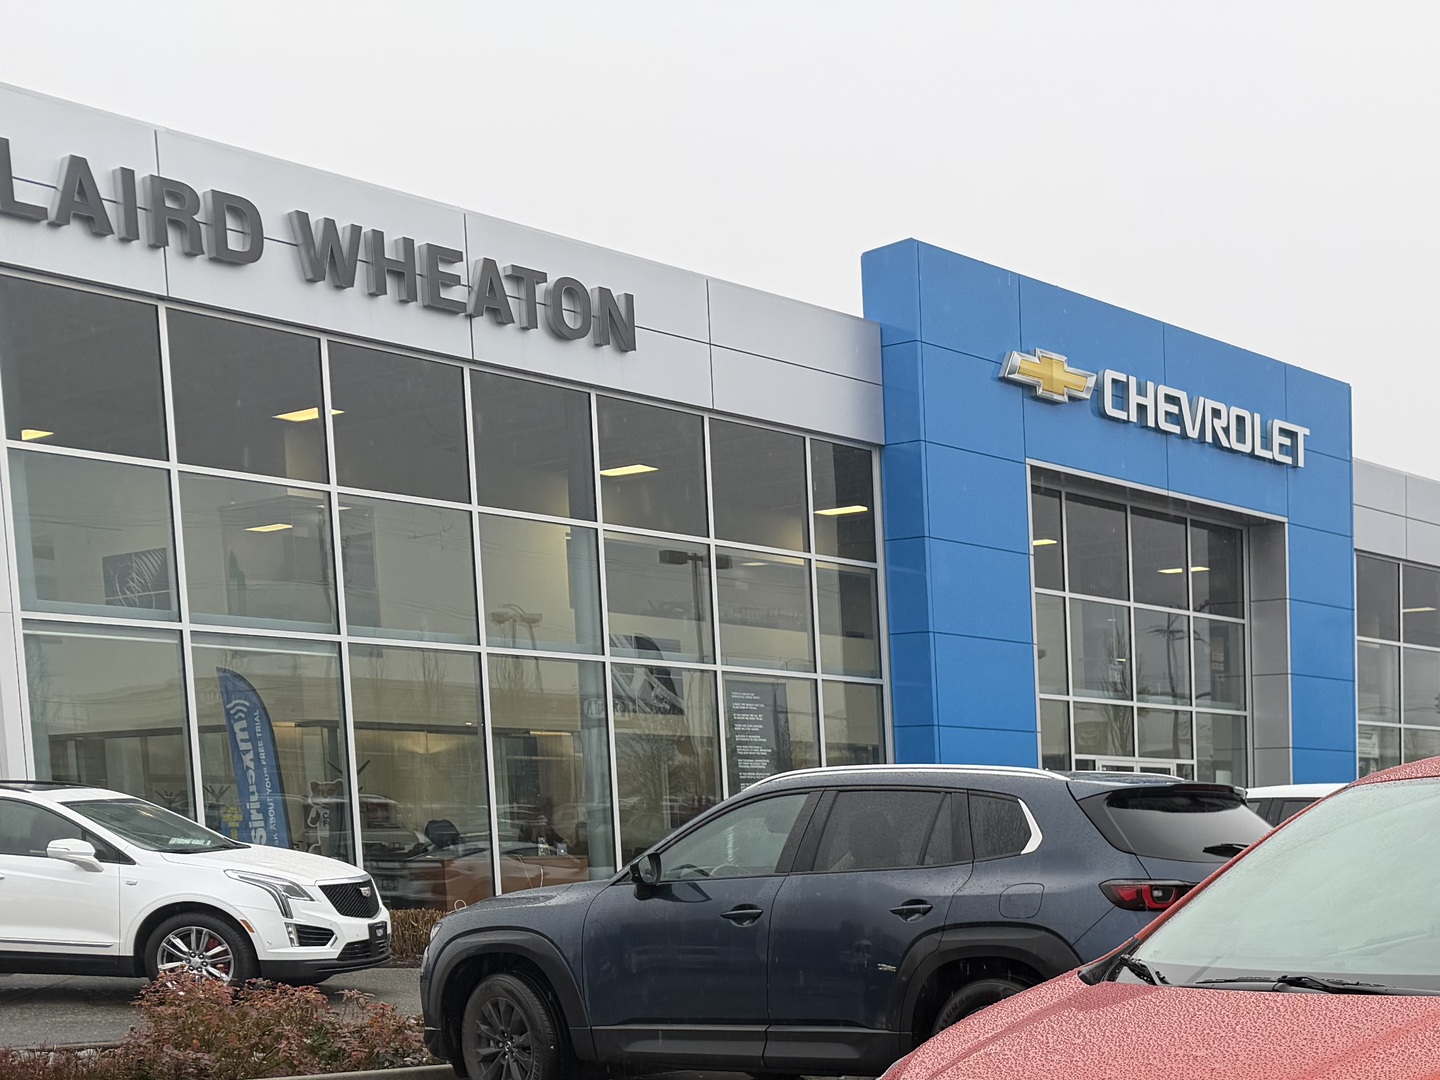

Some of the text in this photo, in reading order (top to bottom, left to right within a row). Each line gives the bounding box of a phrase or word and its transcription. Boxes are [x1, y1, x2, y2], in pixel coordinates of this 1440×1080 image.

[0, 136, 637, 353] LAIRD WHEATON
[1101, 368, 1310, 468] CHEVROLET
[254, 709, 262, 738] TRIAL
[257, 740, 266, 765] FREE
[267, 798, 277, 831] ABOUT
